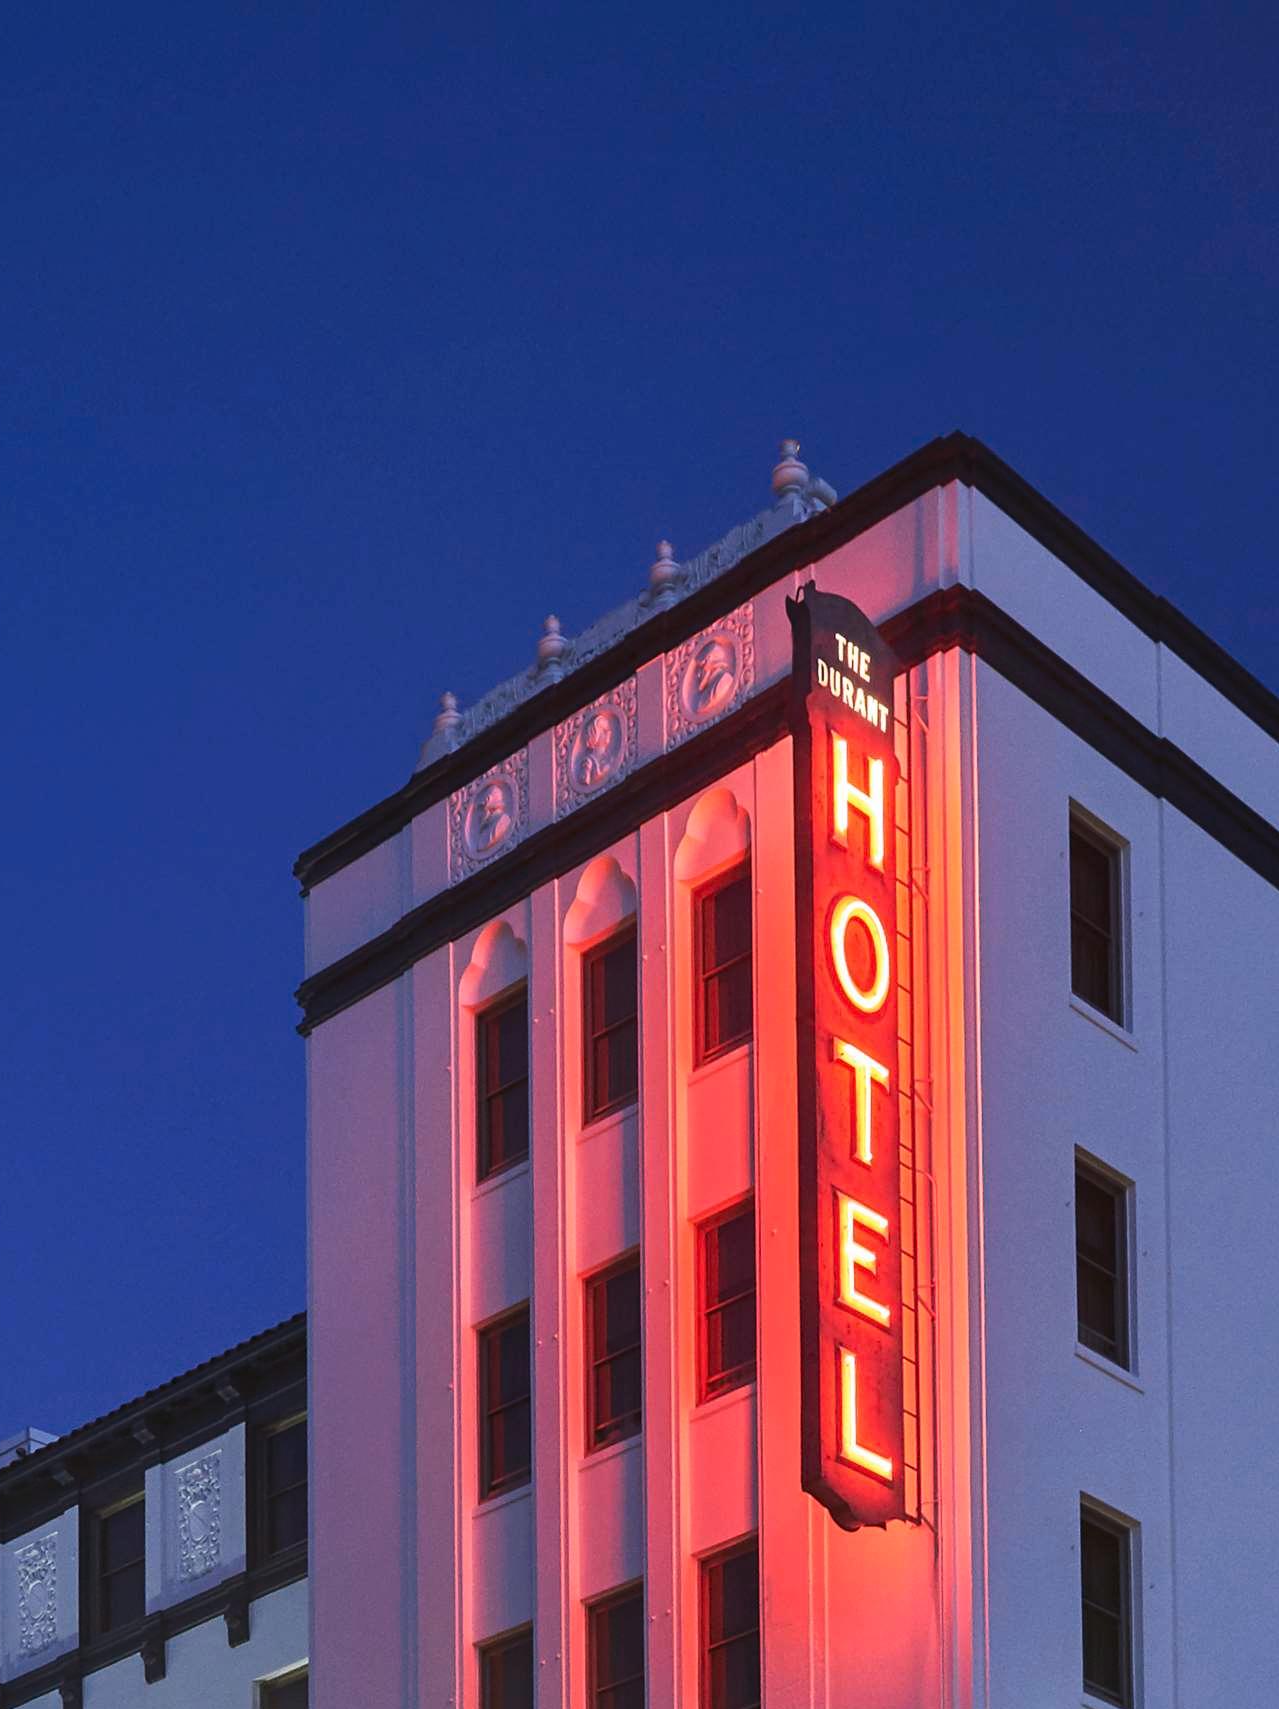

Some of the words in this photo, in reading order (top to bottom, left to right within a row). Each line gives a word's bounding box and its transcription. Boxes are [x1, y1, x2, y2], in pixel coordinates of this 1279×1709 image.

[817, 657, 889, 734] DURANT
[835, 632, 871, 683] THE
[828, 730, 893, 1483] HOTEL
